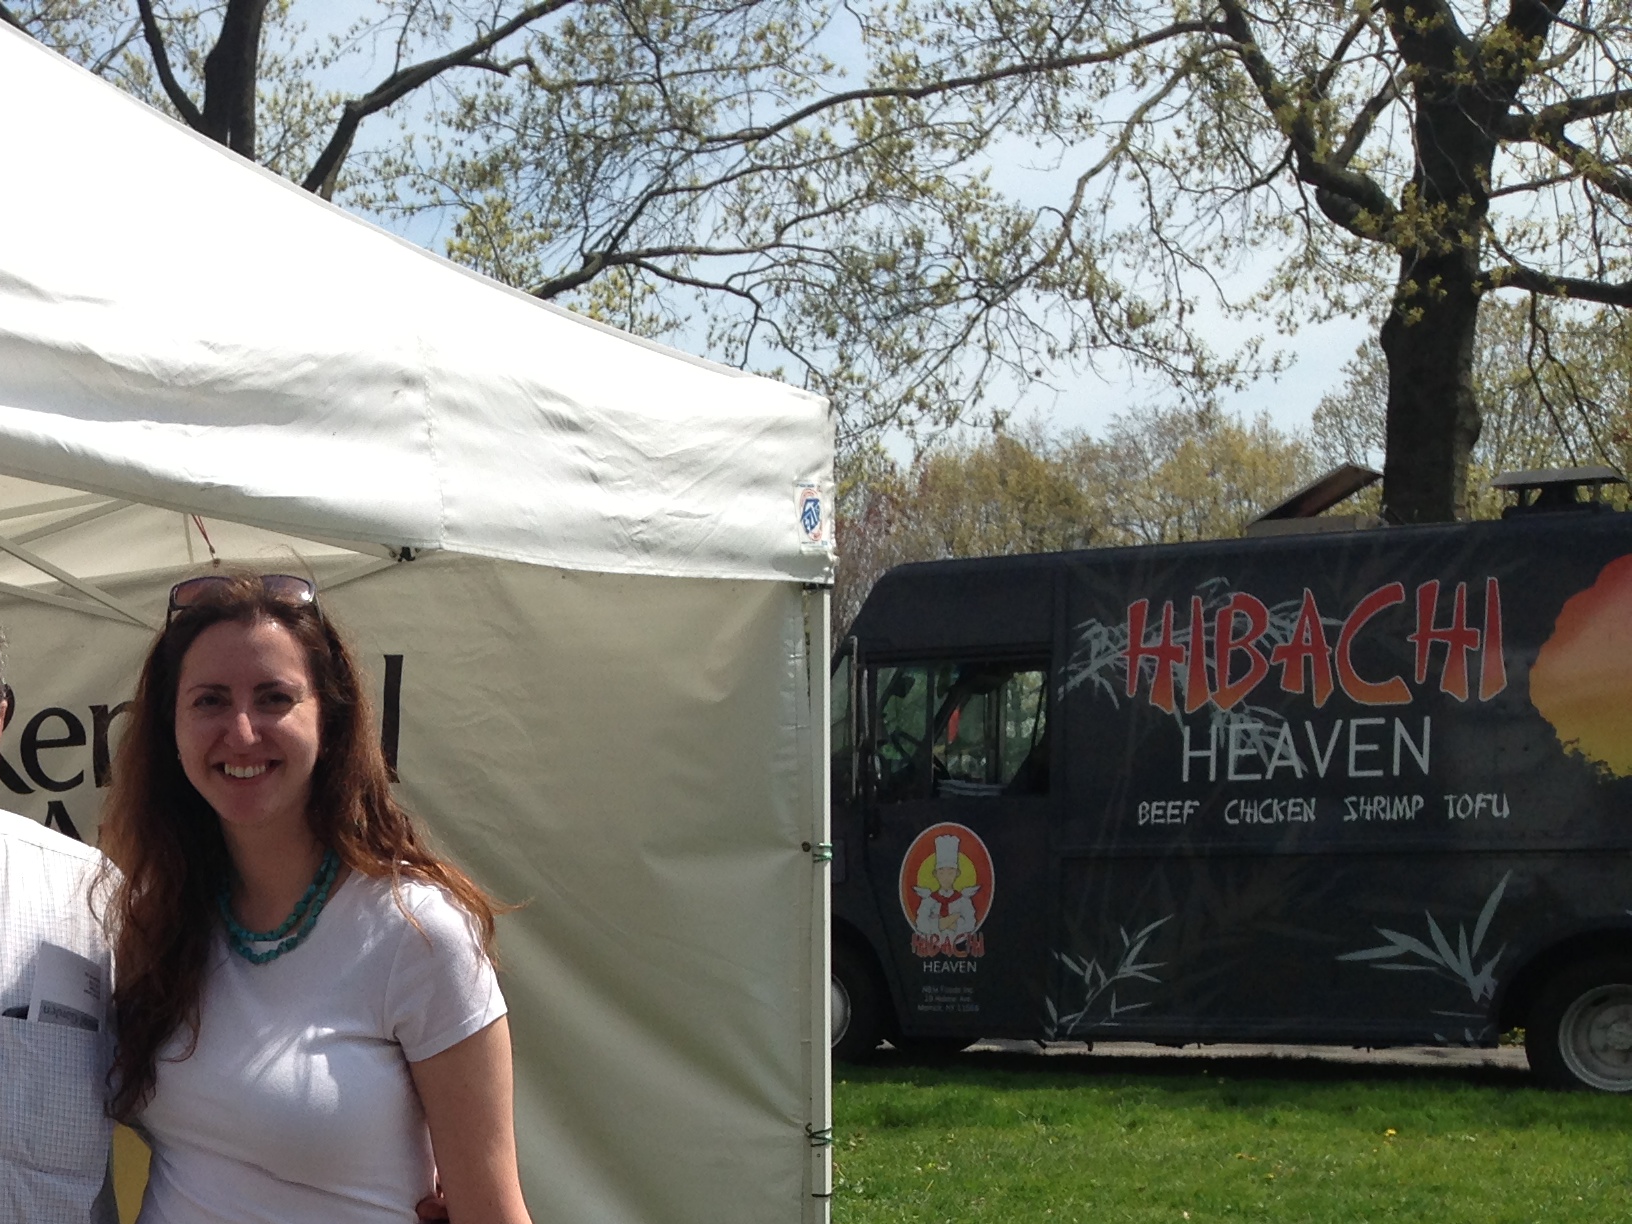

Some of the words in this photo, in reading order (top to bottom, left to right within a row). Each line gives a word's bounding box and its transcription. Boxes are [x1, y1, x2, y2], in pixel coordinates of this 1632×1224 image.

[1122, 576, 1507, 714] HIBACHI
[1182, 715, 1431, 782] HEAVEN
[1137, 799, 1200, 825] BEEF
[1224, 797, 1316, 824] CHICKEN
[1343, 793, 1424, 822] SHRIMP
[1444, 791, 1510, 818] TOFU
[911, 932, 985, 957] HIBACHI
[923, 961, 977, 973] HEAVEN
